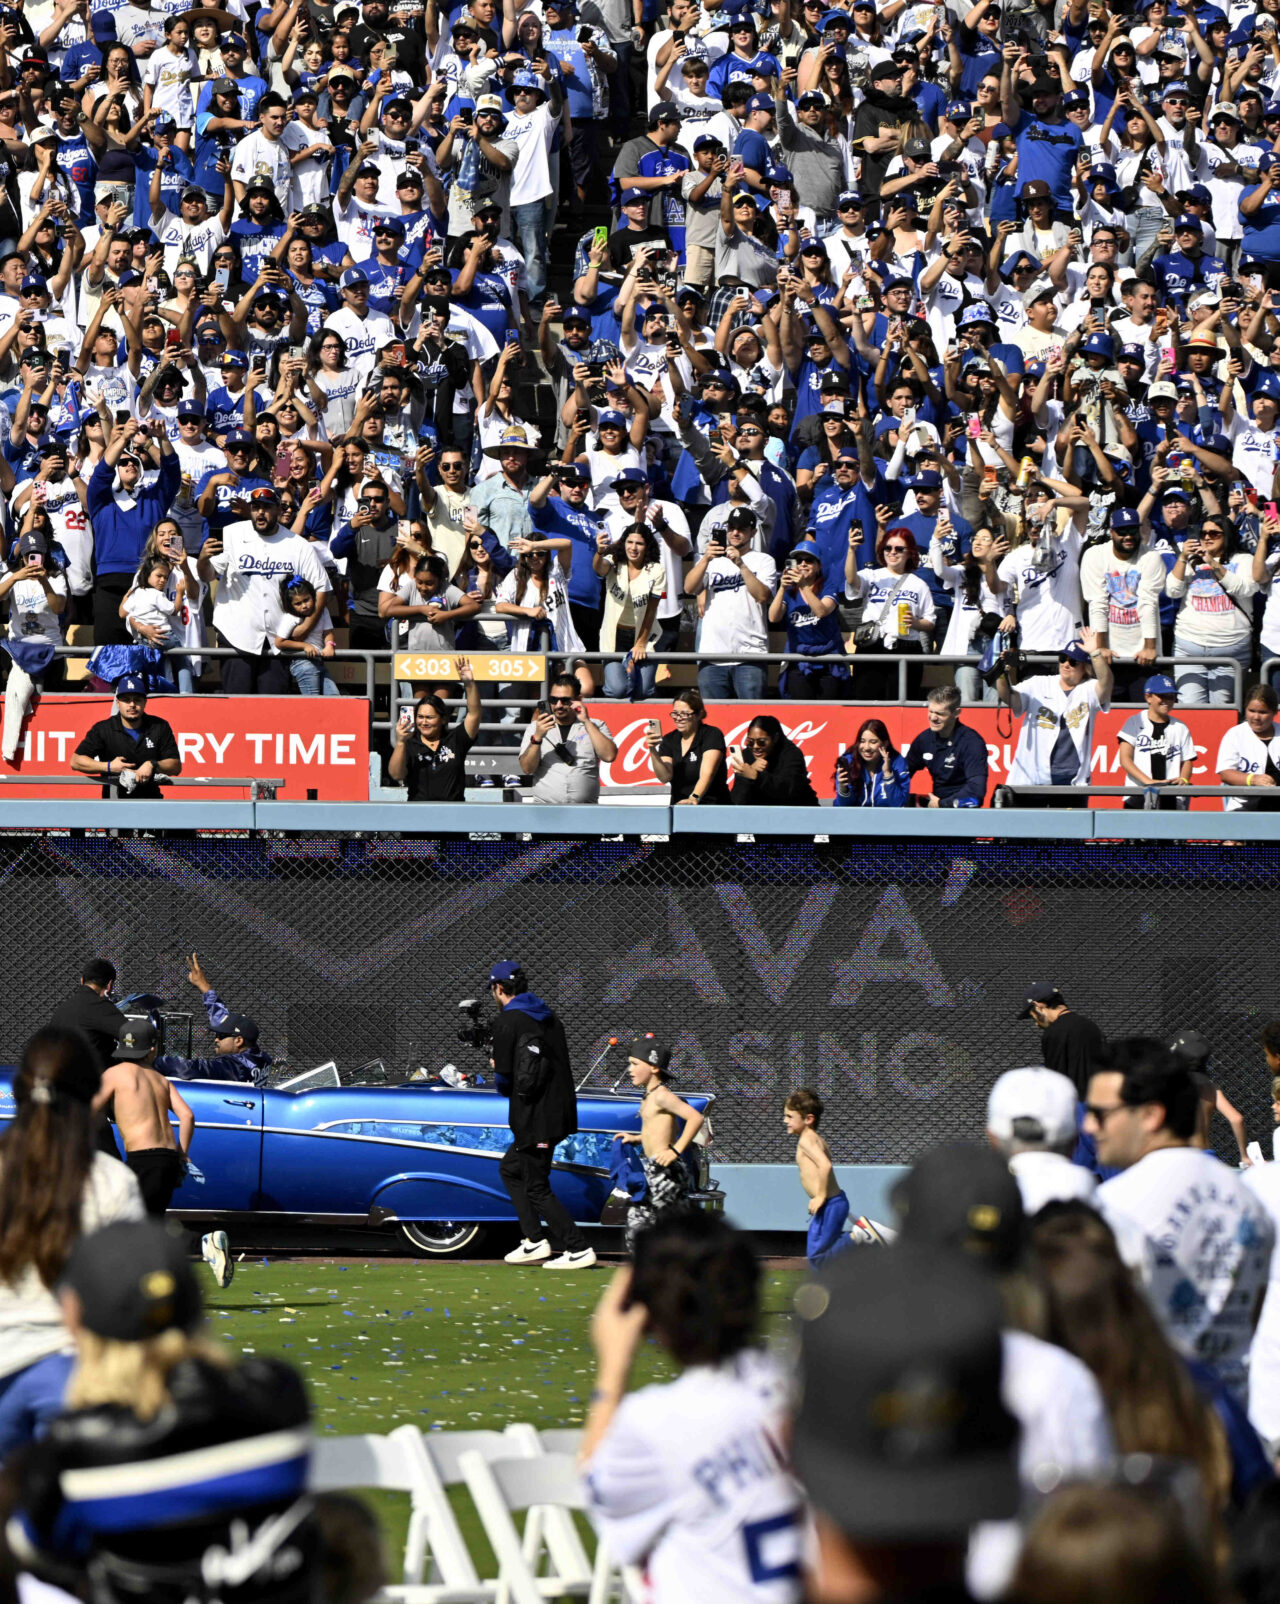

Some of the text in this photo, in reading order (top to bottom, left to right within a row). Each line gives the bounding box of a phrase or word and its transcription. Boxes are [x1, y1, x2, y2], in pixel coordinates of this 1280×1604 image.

[55, 148, 88, 167] odgers
[72, 167, 87, 182] 50
[346, 337, 376, 358] Dodg
[218, 487, 251, 502] Dodg
[65, 510, 86, 531] 22
[239, 554, 294, 578] Dodgers
[545, 587, 565, 611] PAN
[415, 659, 523, 676] 303 305
[245, 733, 356, 765] TIME
[592, 1029, 950, 1100] CASINO
[692, 1426, 780, 1508] PHI
